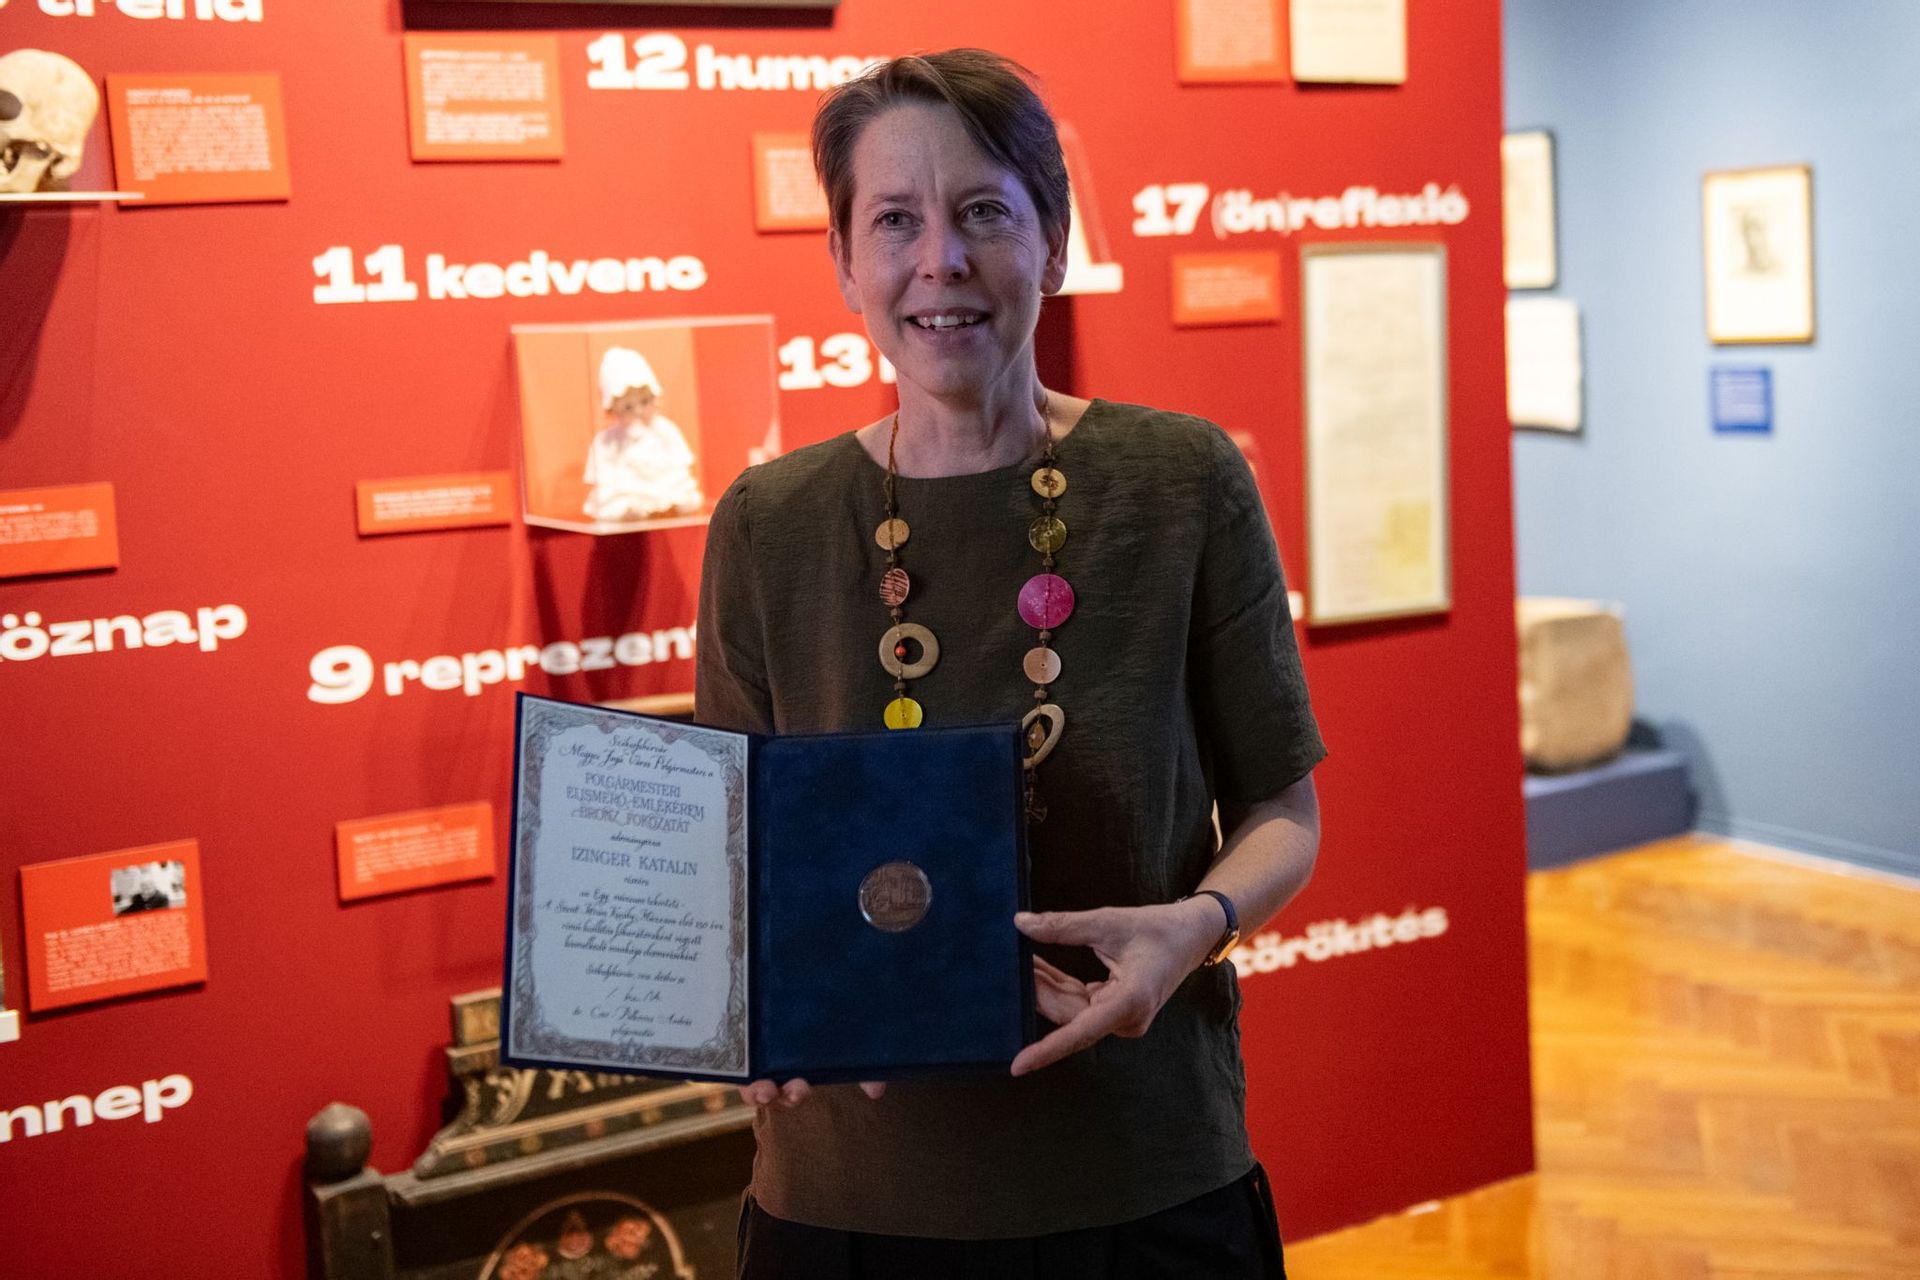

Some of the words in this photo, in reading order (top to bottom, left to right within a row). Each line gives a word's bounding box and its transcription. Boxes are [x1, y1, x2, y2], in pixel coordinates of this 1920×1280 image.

[586, 33, 690, 90] 12
[696, 44, 892, 90] huma
[1132, 183, 1209, 237] 17
[1211, 182, 1469, 240] (ön)reflexió
[312, 244, 418, 304] 11
[426, 250, 708, 300] kedvenc
[778, 332, 873, 391] 13
[0, 604, 248, 662] öznap
[307, 645, 374, 704] 9
[585, 771, 681, 798] POLGÁRMESTERI
[571, 846, 631, 868] IZINGER
[639, 855, 698, 876] KATALIN
